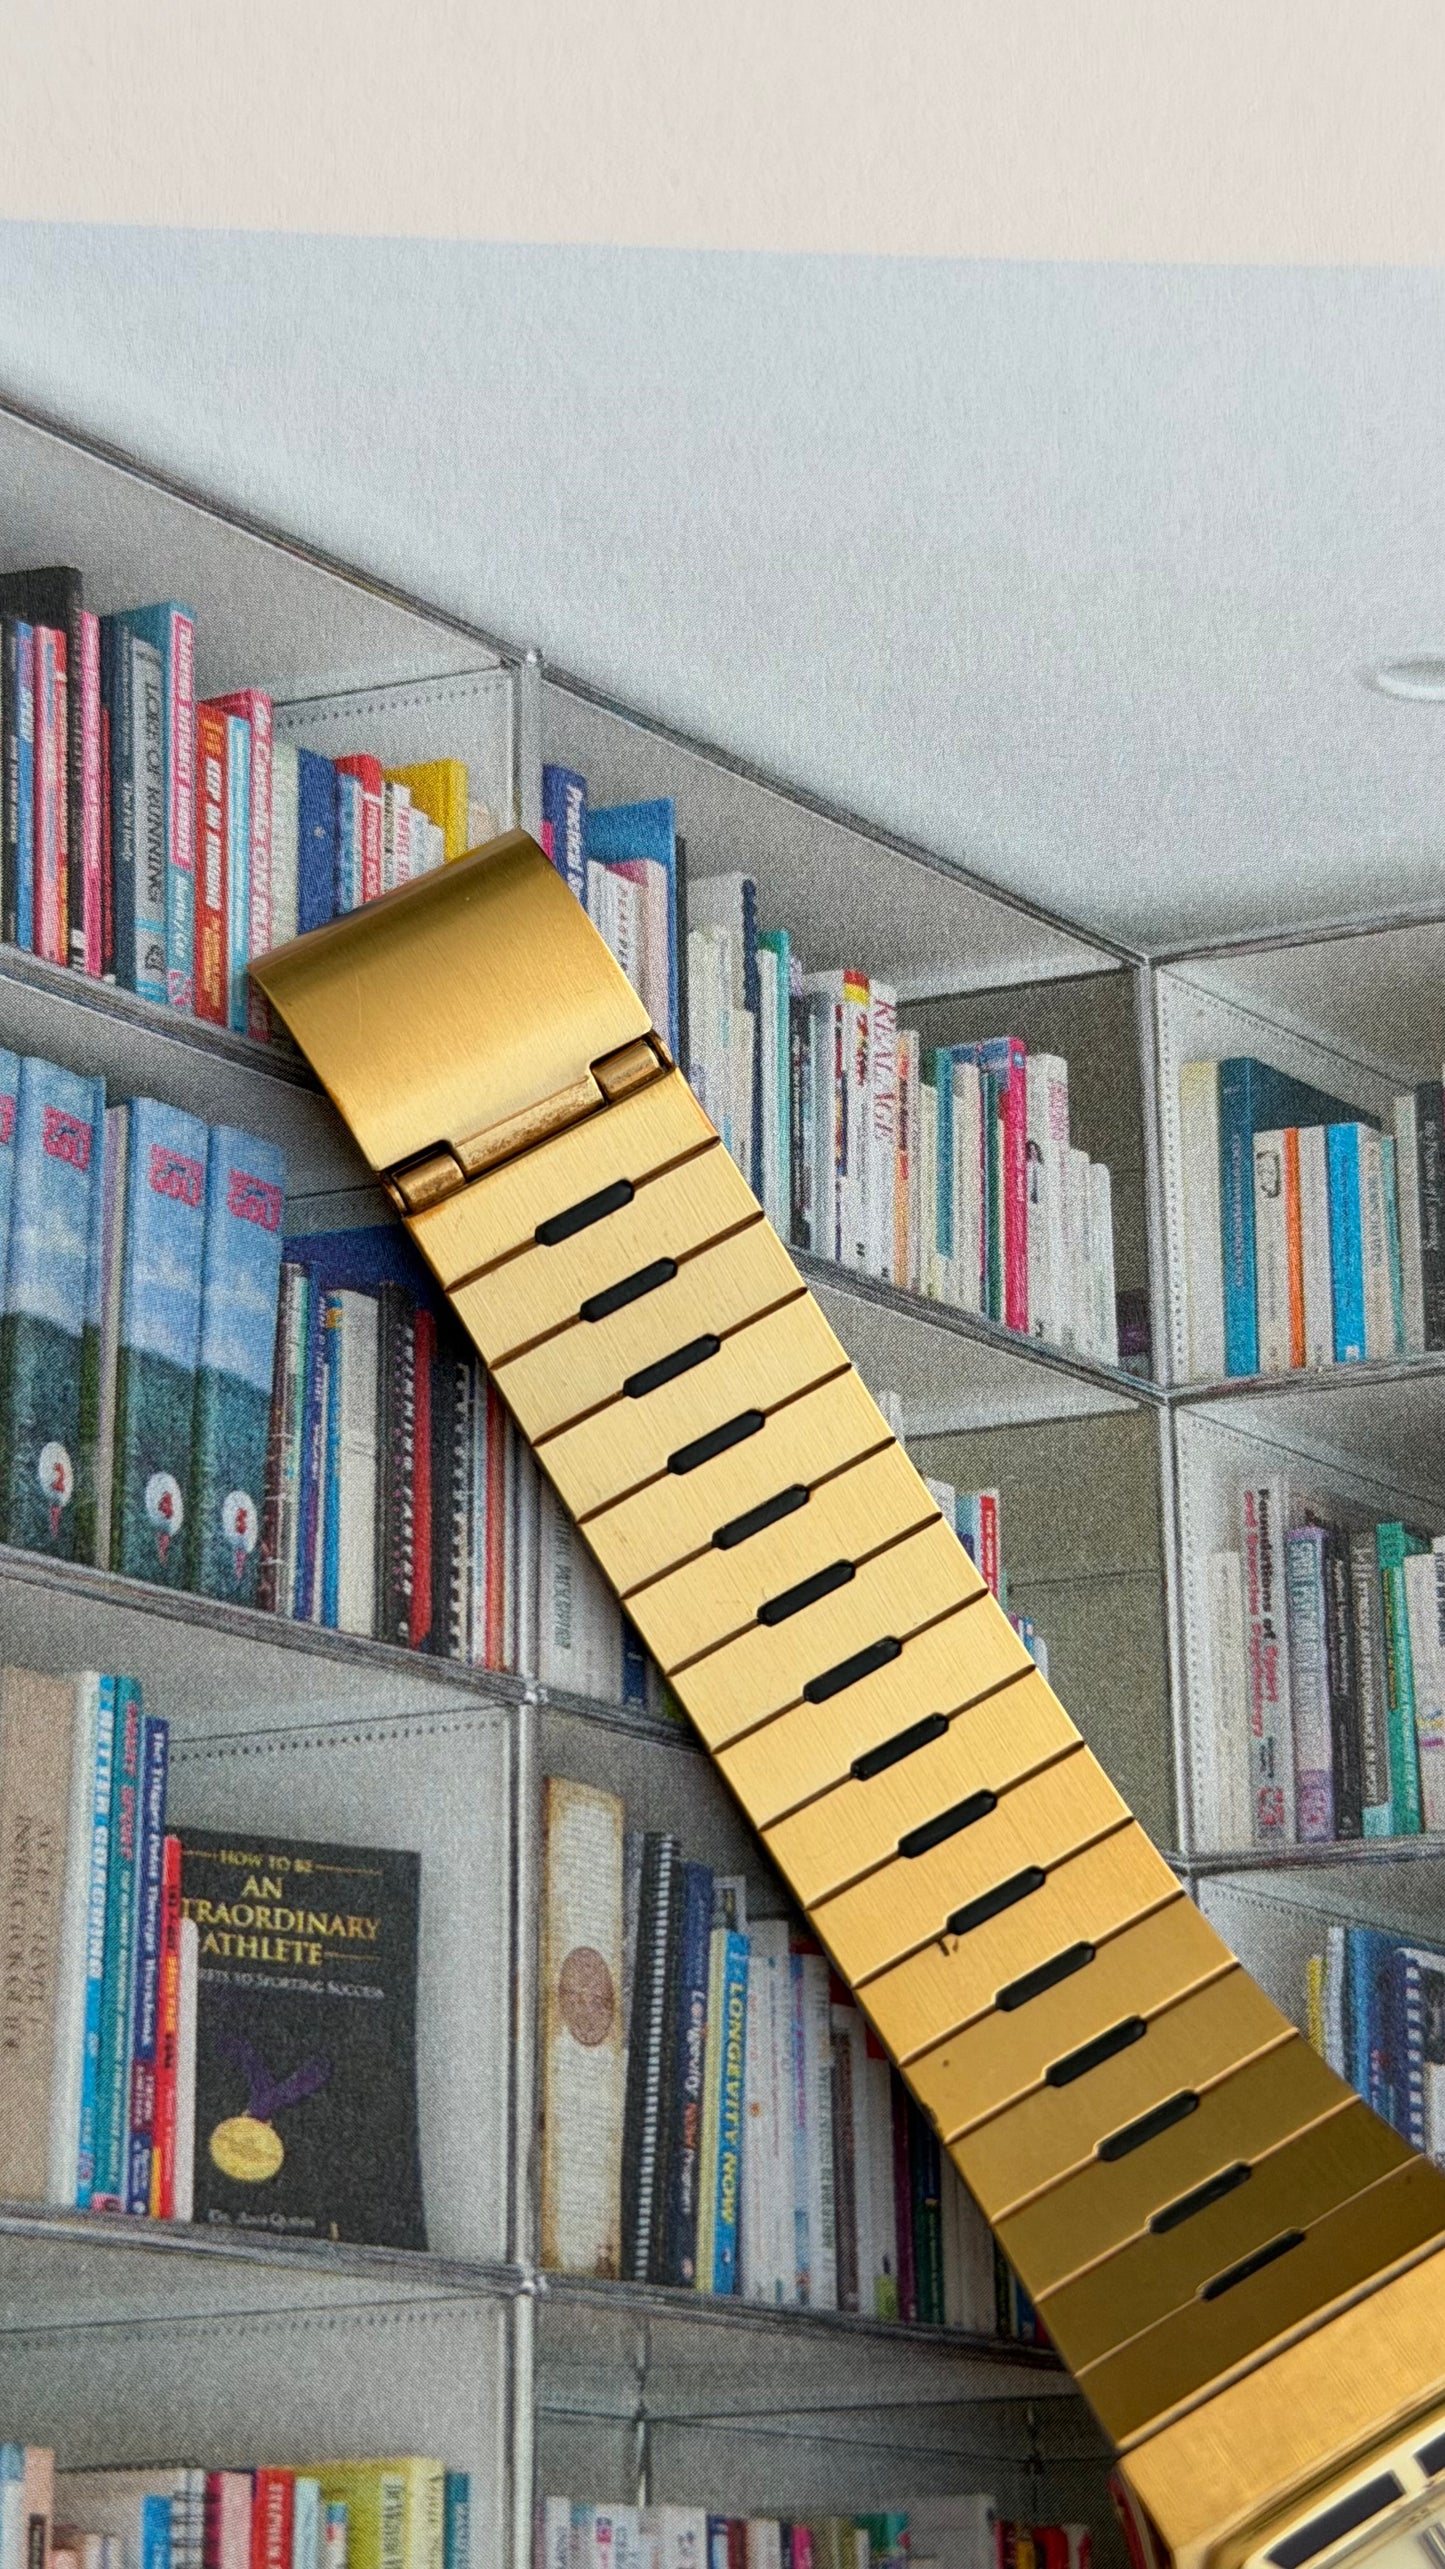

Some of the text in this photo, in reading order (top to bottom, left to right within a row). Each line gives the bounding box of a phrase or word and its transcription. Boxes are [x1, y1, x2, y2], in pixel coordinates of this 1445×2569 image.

[20, 686, 32, 742] SPEED
[145, 682, 160, 741] LORE
[254, 702, 271, 734] de
[146, 749, 161, 779] OF
[174, 624, 193, 860] TRAINING DISTANCE RUNNERS
[206, 756, 220, 801] KEEP
[253, 741, 270, 840] Castella
[146, 786, 162, 902] RUNNING
[206, 803, 220, 829] ON
[566, 784, 581, 872] Practical
[206, 832, 220, 910] RUNNING
[253, 846, 269, 886] ON
[51, 1461, 66, 1493] 2
[1244, 1490, 1265, 1736] and Exercise Psychology
[1258, 1489, 1279, 1702] Foundations of Sport
[1357, 1581, 1370, 1626] STRESS
[1359, 1630, 1371, 1654] AND
[1360, 1656, 1375, 1746] PERFORMANCE
[153, 1731, 164, 1762] The
[149, 1767, 162, 1830] Trigger
[1365, 1764, 1377, 1802] SPORT
[87, 1709, 112, 1978] BETTER COACHING
[118, 1784, 134, 1859] SPORT
[220, 1850, 262, 1868] HOW
[268, 1856, 290, 1872] TO
[241, 1875, 284, 1899] AN
[144, 1884, 158, 1951] Therapy
[182, 1897, 381, 1941] TRAORDINARY
[201, 1932, 323, 1966] ATHLETE
[141, 1958, 155, 2045] Workbook
[685, 1989, 703, 2096] Longevity
[684, 2102, 697, 2148] NOW
[720, 1981, 742, 2224] LONGEVITY NOW
